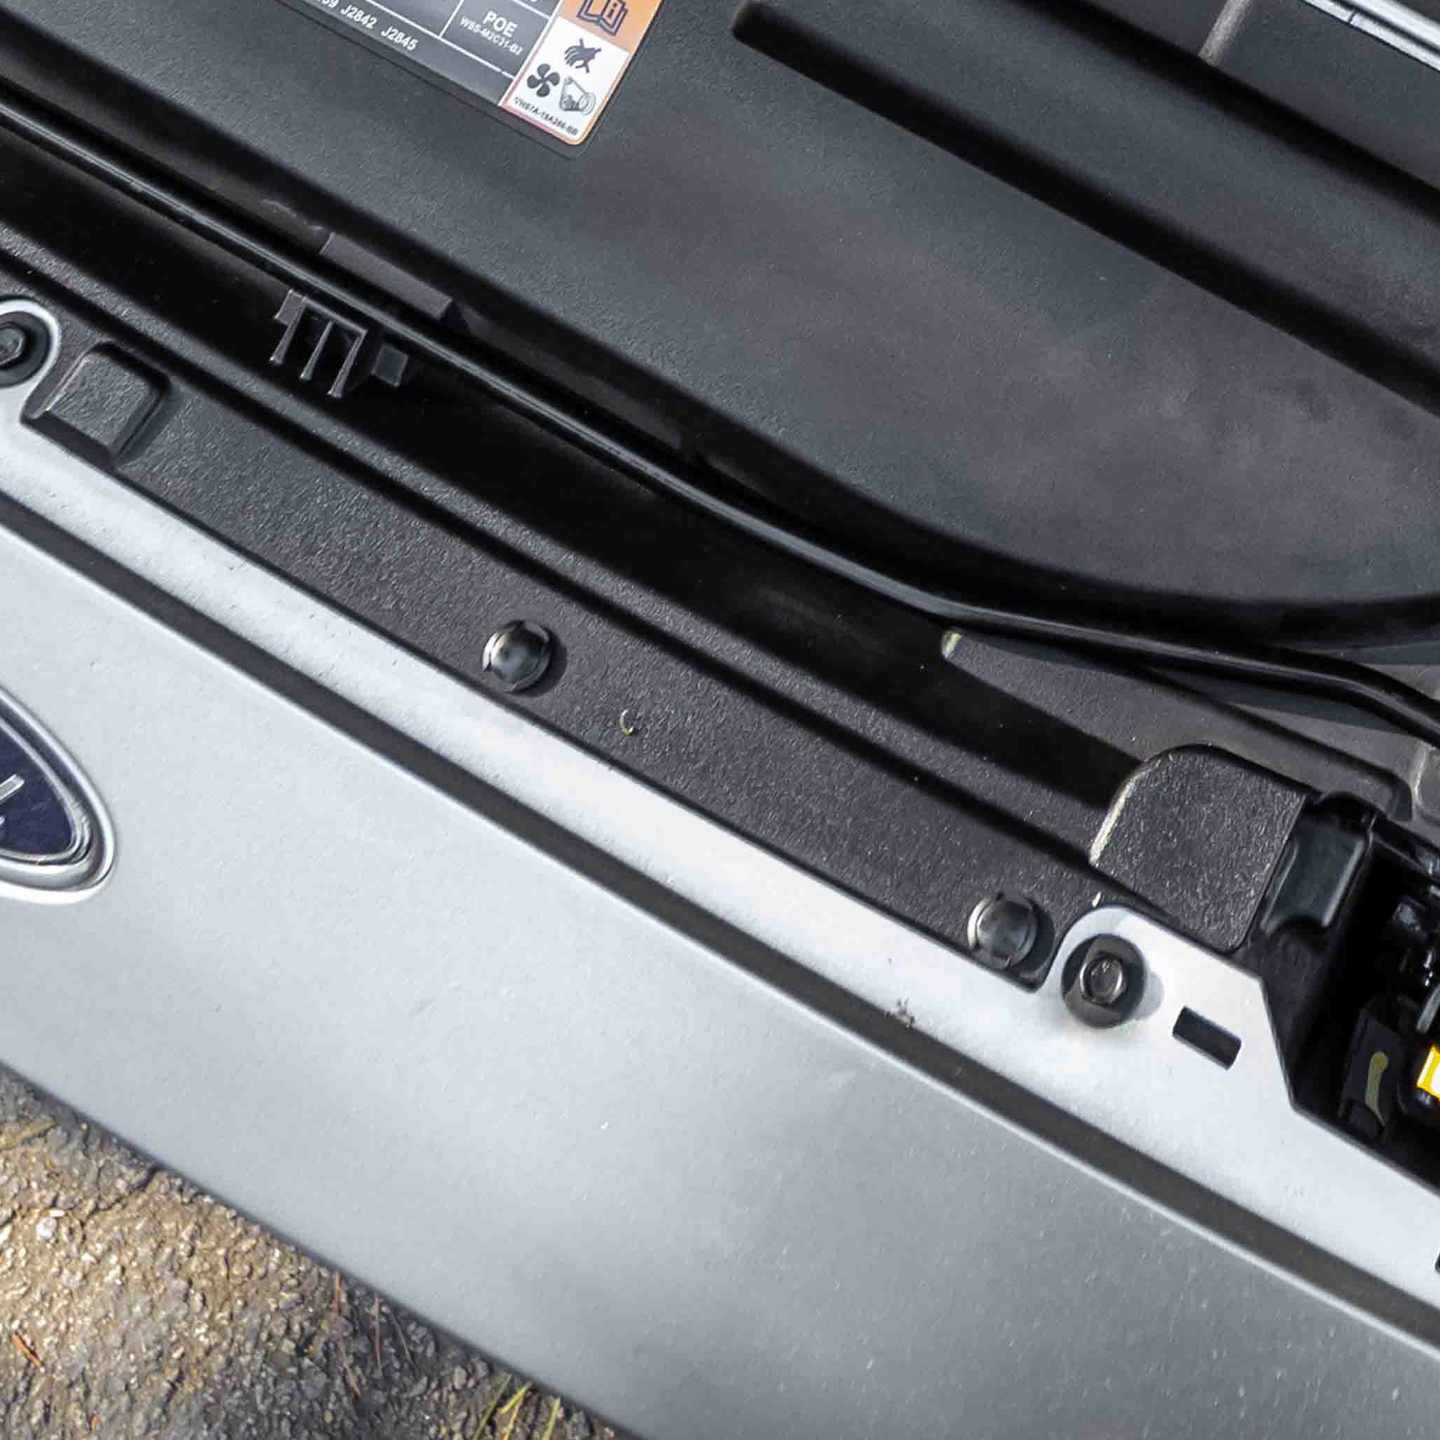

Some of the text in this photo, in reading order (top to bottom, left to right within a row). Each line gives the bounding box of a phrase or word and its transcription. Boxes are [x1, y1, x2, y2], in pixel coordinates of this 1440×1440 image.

[341, 5, 377, 28] J2842
[381, 26, 418, 50] J2845
[483, 11, 517, 37] POE
